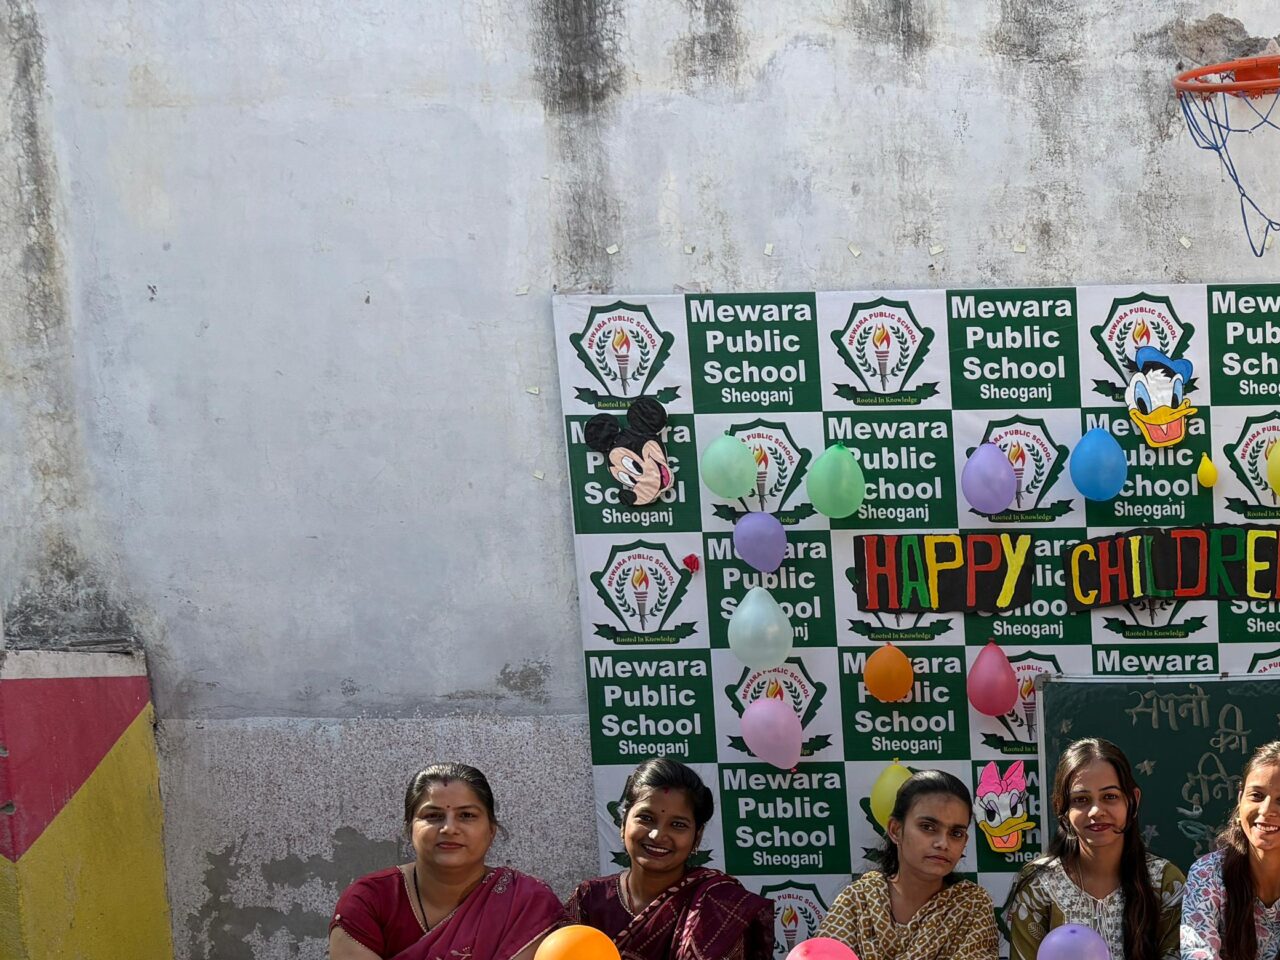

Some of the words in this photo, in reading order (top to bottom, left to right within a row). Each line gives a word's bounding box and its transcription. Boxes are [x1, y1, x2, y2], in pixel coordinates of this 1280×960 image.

[690, 300, 812, 323] Mewara
[952, 296, 1072, 319] Mewara
[588, 319, 607, 349] MEWARA
[608, 315, 635, 324] PUBLIC
[635, 319, 657, 350] SCHOOL
[847, 316, 868, 346] MEWARA
[869, 312, 896, 321] PUBLIC
[896, 316, 917, 345] SCHOOL
[1108, 312, 1129, 342] MEWARA
[1129, 307, 1156, 316] PUBLIC
[1157, 312, 1177, 341] SCHOOL
[707, 330, 800, 352] Public
[966, 326, 1060, 349] Public
[704, 360, 805, 383] School
[963, 356, 1065, 380] School
[721, 388, 793, 406] Sheoganj
[887, 395, 917, 404] Knowledge
[980, 384, 1052, 401] Sheoganj
[828, 418, 948, 440] Mewara
[746, 433, 772, 442] PUBLIC
[772, 435, 795, 466] SCHOOL
[1004, 430, 1030, 439] PUBLIC
[1030, 435, 1052, 462] SCHOOL
[1126, 446, 1193, 466] ublic
[1240, 433, 1261, 460] MEWARA
[863, 480, 942, 500] chool
[1120, 474, 1198, 497] chool
[602, 509, 673, 525] Sheoganj
[858, 504, 929, 521] Sheoganj
[1020, 513, 1051, 521] Knowledge
[1115, 502, 1185, 518] Sheoganj
[608, 560, 628, 587] MEWARA
[628, 554, 654, 563] PUBLIC
[654, 558, 675, 586] SCHOOL
[863, 534, 1029, 611] HAPPY
[645, 635, 676, 643] Knowledge
[900, 632, 931, 640] Knowledge
[993, 621, 1063, 638] Sheoganj
[1155, 629, 1185, 637] Knowledge
[589, 656, 707, 678] Mewara
[1097, 650, 1213, 672] Mewara
[604, 685, 696, 707] Public
[742, 671, 762, 699] MEWARA
[789, 671, 810, 699] SCHOOL
[601, 714, 701, 736] School
[854, 711, 955, 732] School
[618, 740, 689, 756] Sheoganj
[872, 737, 942, 752] Sheoganj
[723, 769, 841, 790] Mewara
[738, 798, 830, 818] Public
[736, 825, 835, 848] School
[752, 851, 823, 868] Sheoganj
[778, 894, 804, 903] PUBLIC
